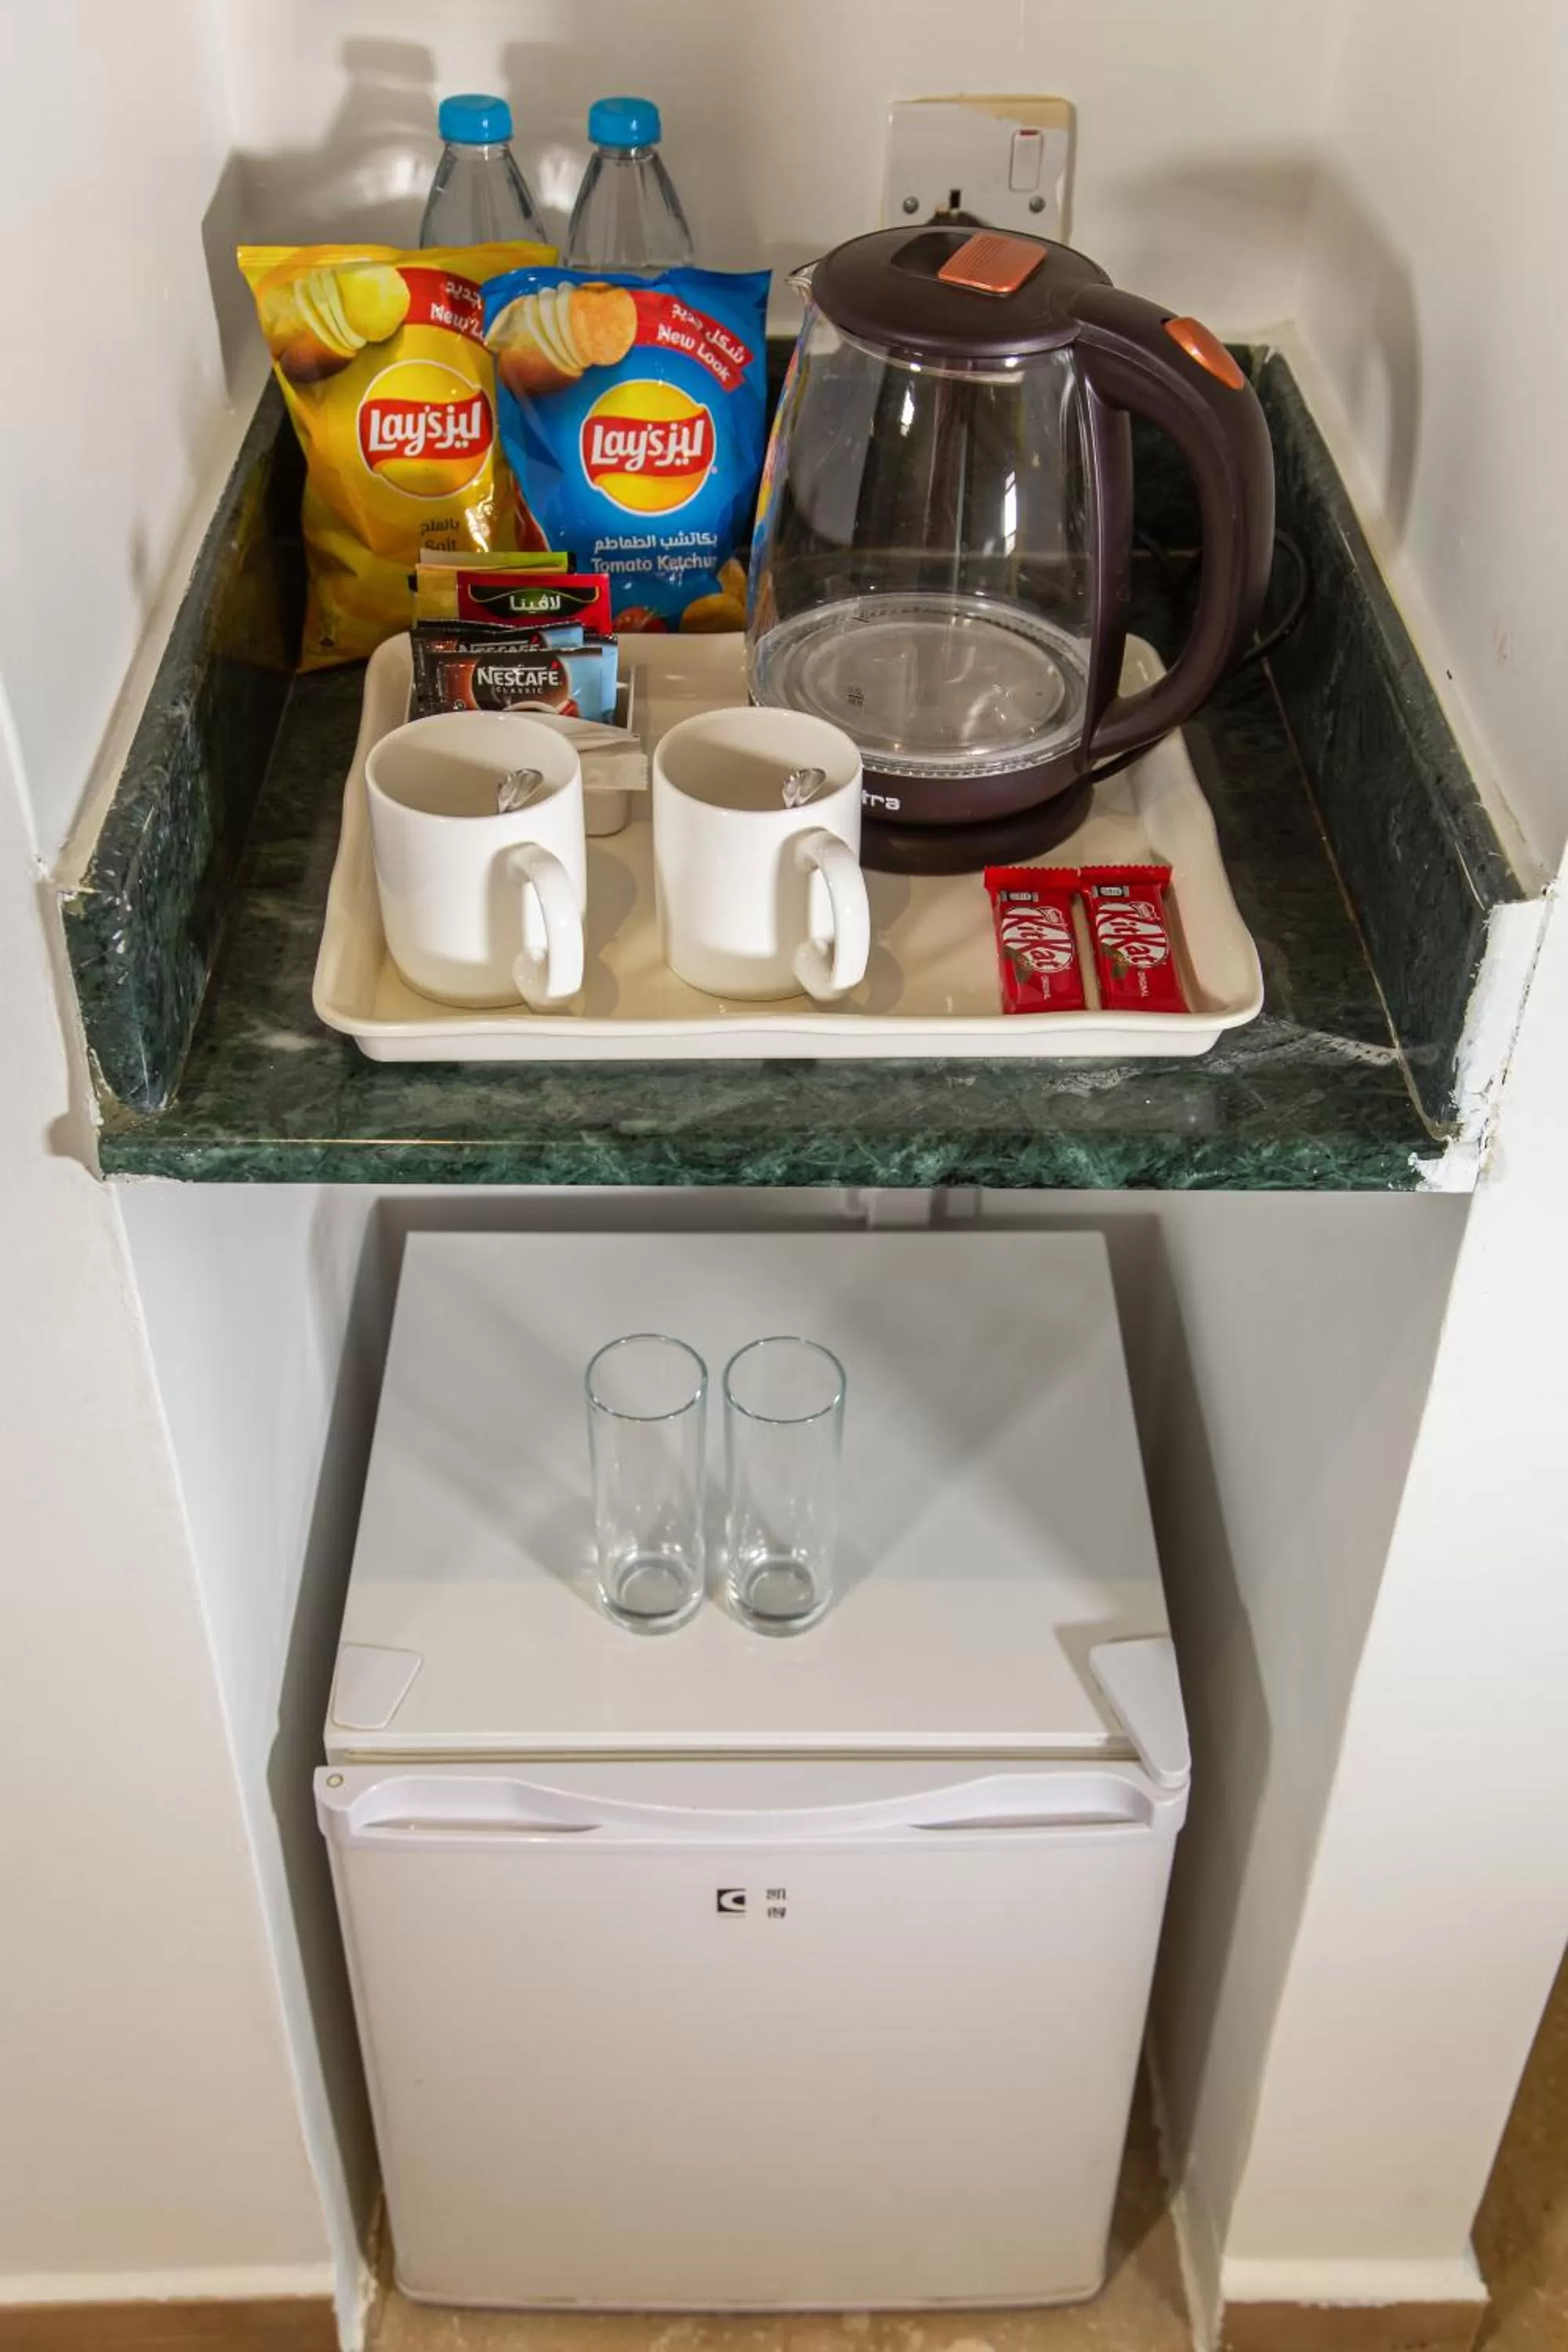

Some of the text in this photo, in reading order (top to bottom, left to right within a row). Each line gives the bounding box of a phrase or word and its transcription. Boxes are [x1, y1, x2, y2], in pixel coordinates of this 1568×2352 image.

[657, 323, 730, 382] New Look
[368, 405, 444, 457] Lay's
[434, 401, 482, 449] ليز
[590, 423, 666, 472] Lay's
[654, 419, 706, 467] ليز
[590, 556, 653, 575] Tomato
[593, 534, 657, 554] الطماطم
[494, 686, 544, 695] CLASSIC
